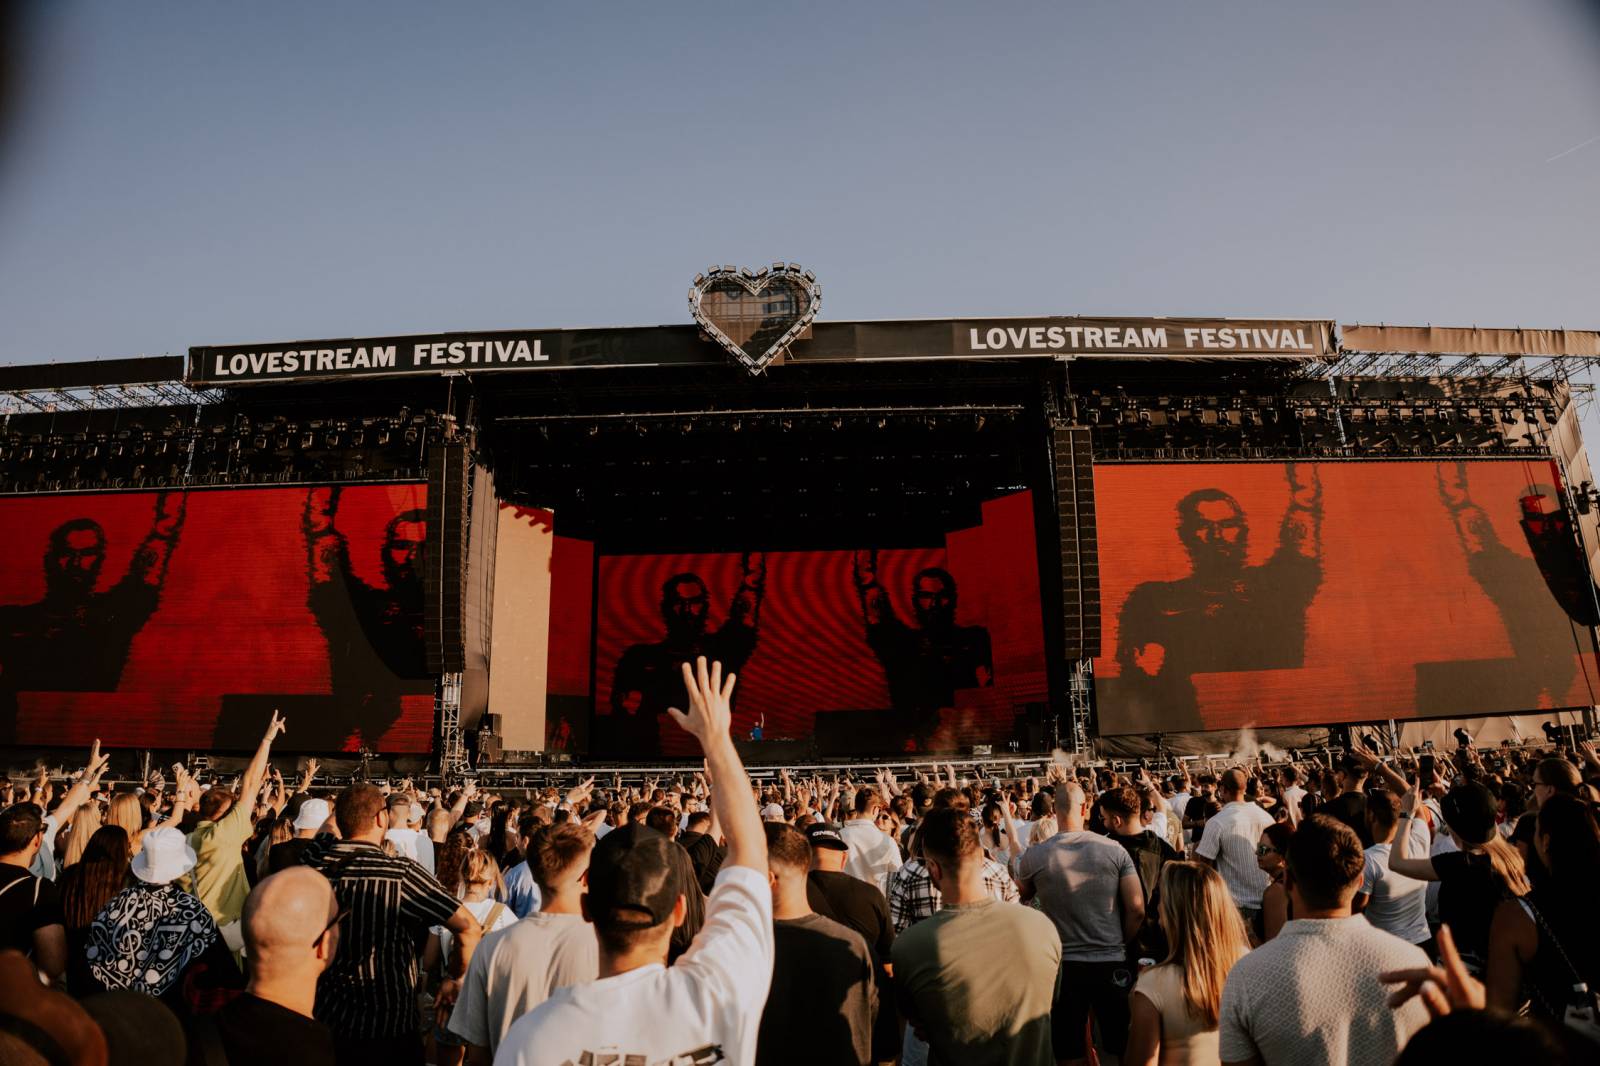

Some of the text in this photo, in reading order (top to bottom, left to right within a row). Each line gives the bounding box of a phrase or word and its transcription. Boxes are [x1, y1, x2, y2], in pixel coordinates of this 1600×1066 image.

[970, 327, 1313, 349] LOVESTREAM FESTIVAL
[216, 340, 548, 375] LOVESTREAM FESTIVAL
